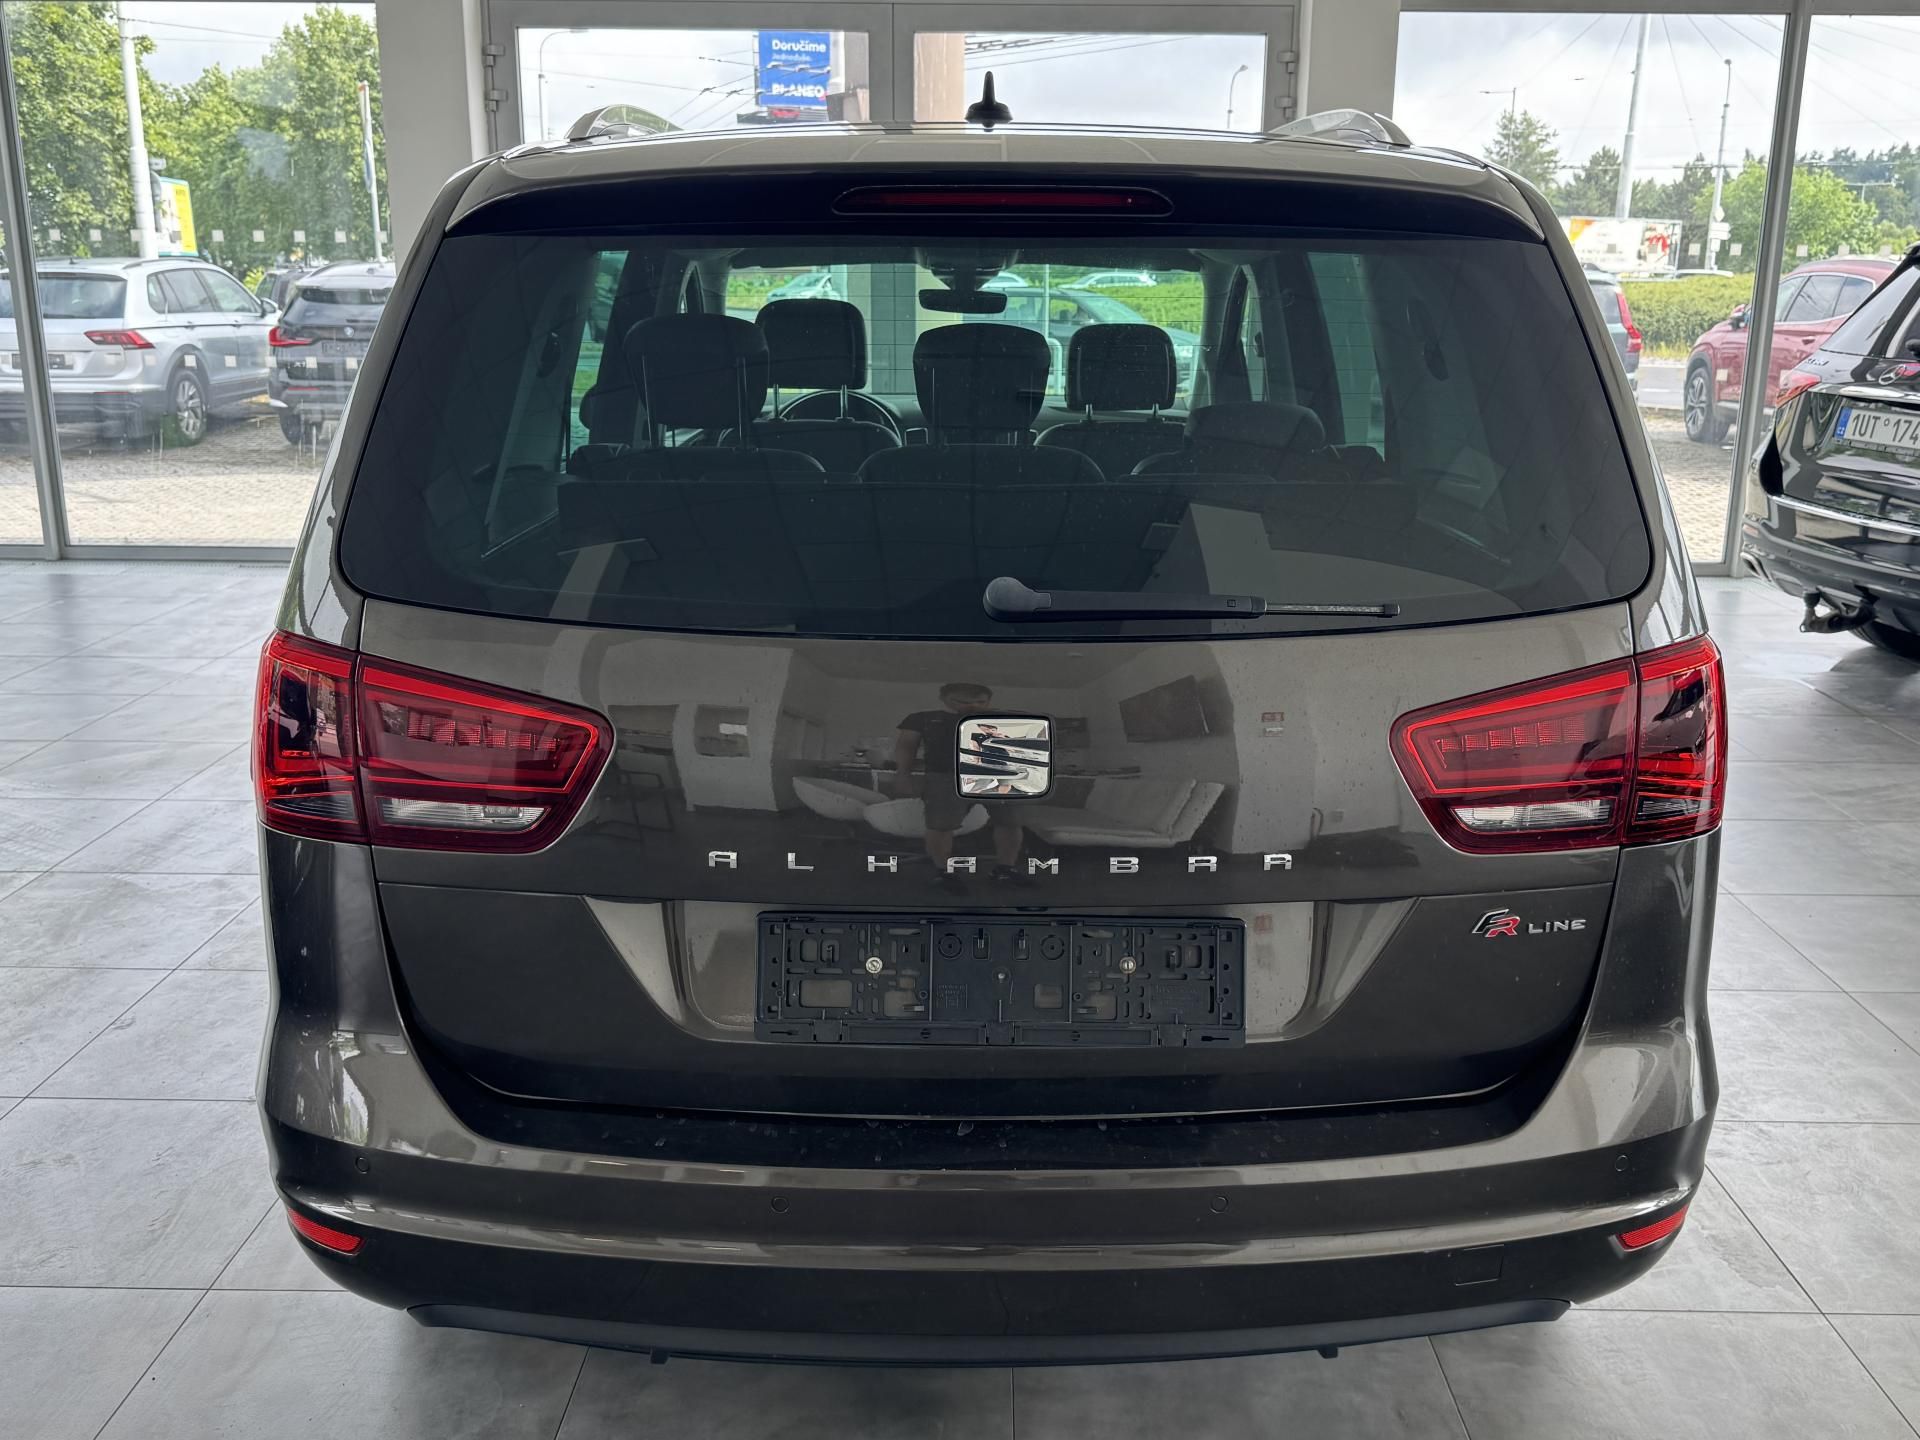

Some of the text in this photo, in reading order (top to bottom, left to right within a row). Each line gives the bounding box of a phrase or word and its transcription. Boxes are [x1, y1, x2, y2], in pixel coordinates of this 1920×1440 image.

[772, 40, 826, 52] Doručíme
[707, 850, 1293, 875] ALHAMBRA
[1472, 908, 1587, 938] FR LINE
